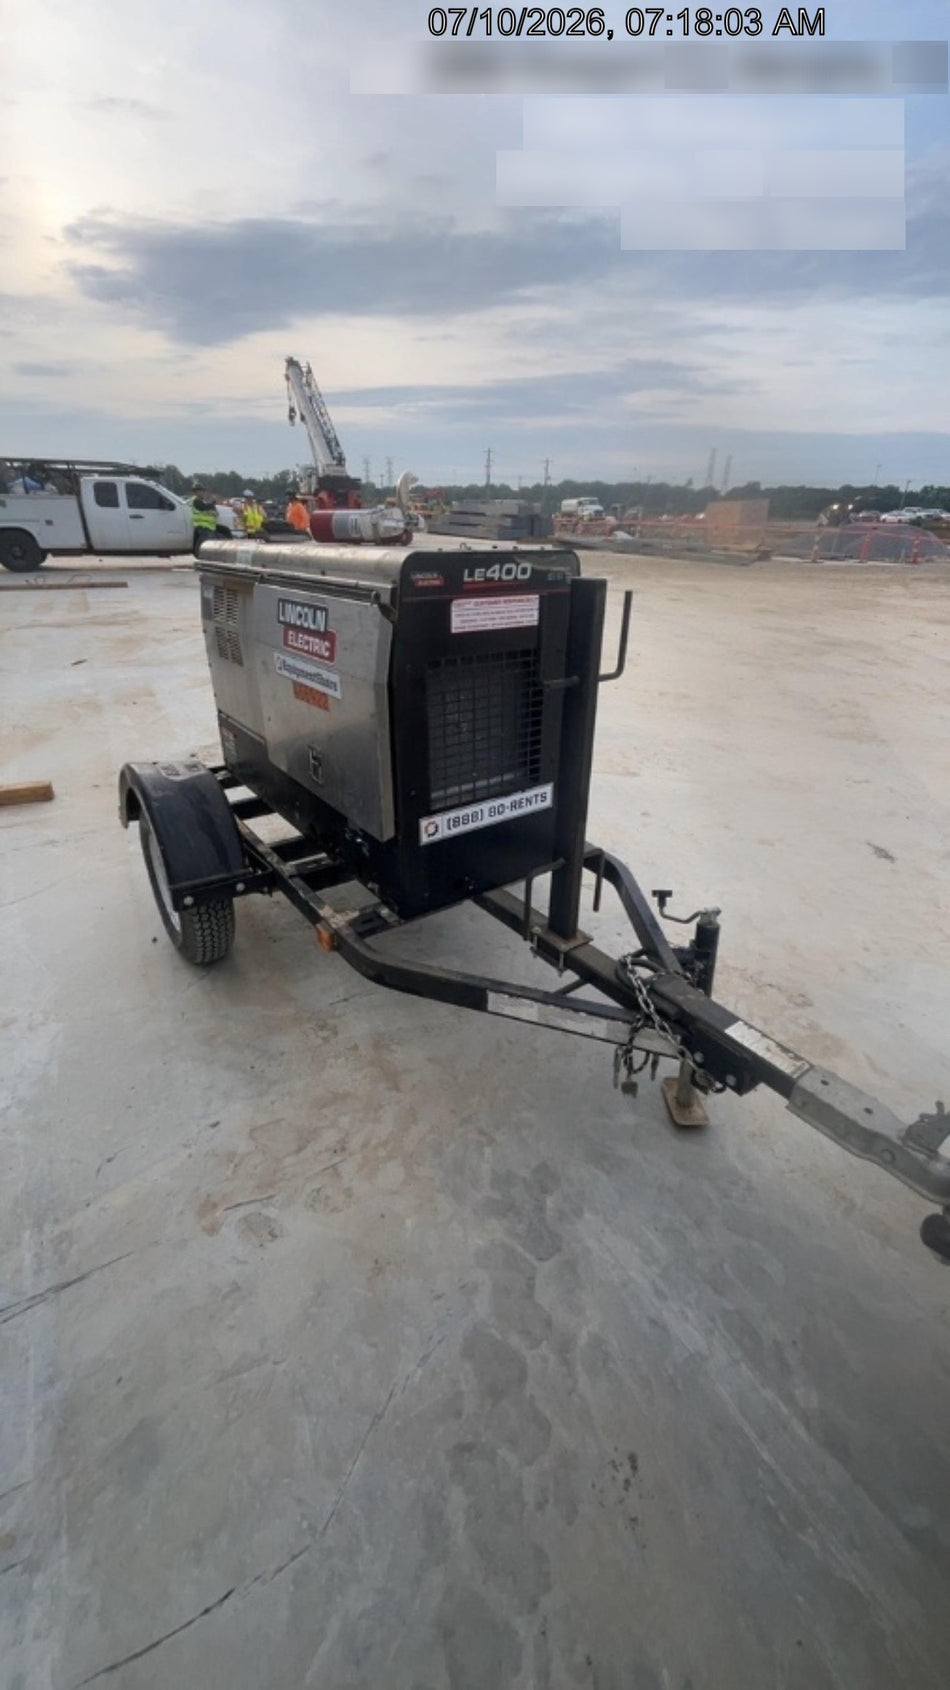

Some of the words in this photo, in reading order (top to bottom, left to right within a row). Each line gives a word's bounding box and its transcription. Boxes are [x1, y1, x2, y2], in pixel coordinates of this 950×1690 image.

[463, 562, 532, 582] LE400
[279, 600, 326, 632] LINCOLN
[287, 630, 331, 657] ELECTRIC
[488, 791, 548, 818] 80-RENTS
